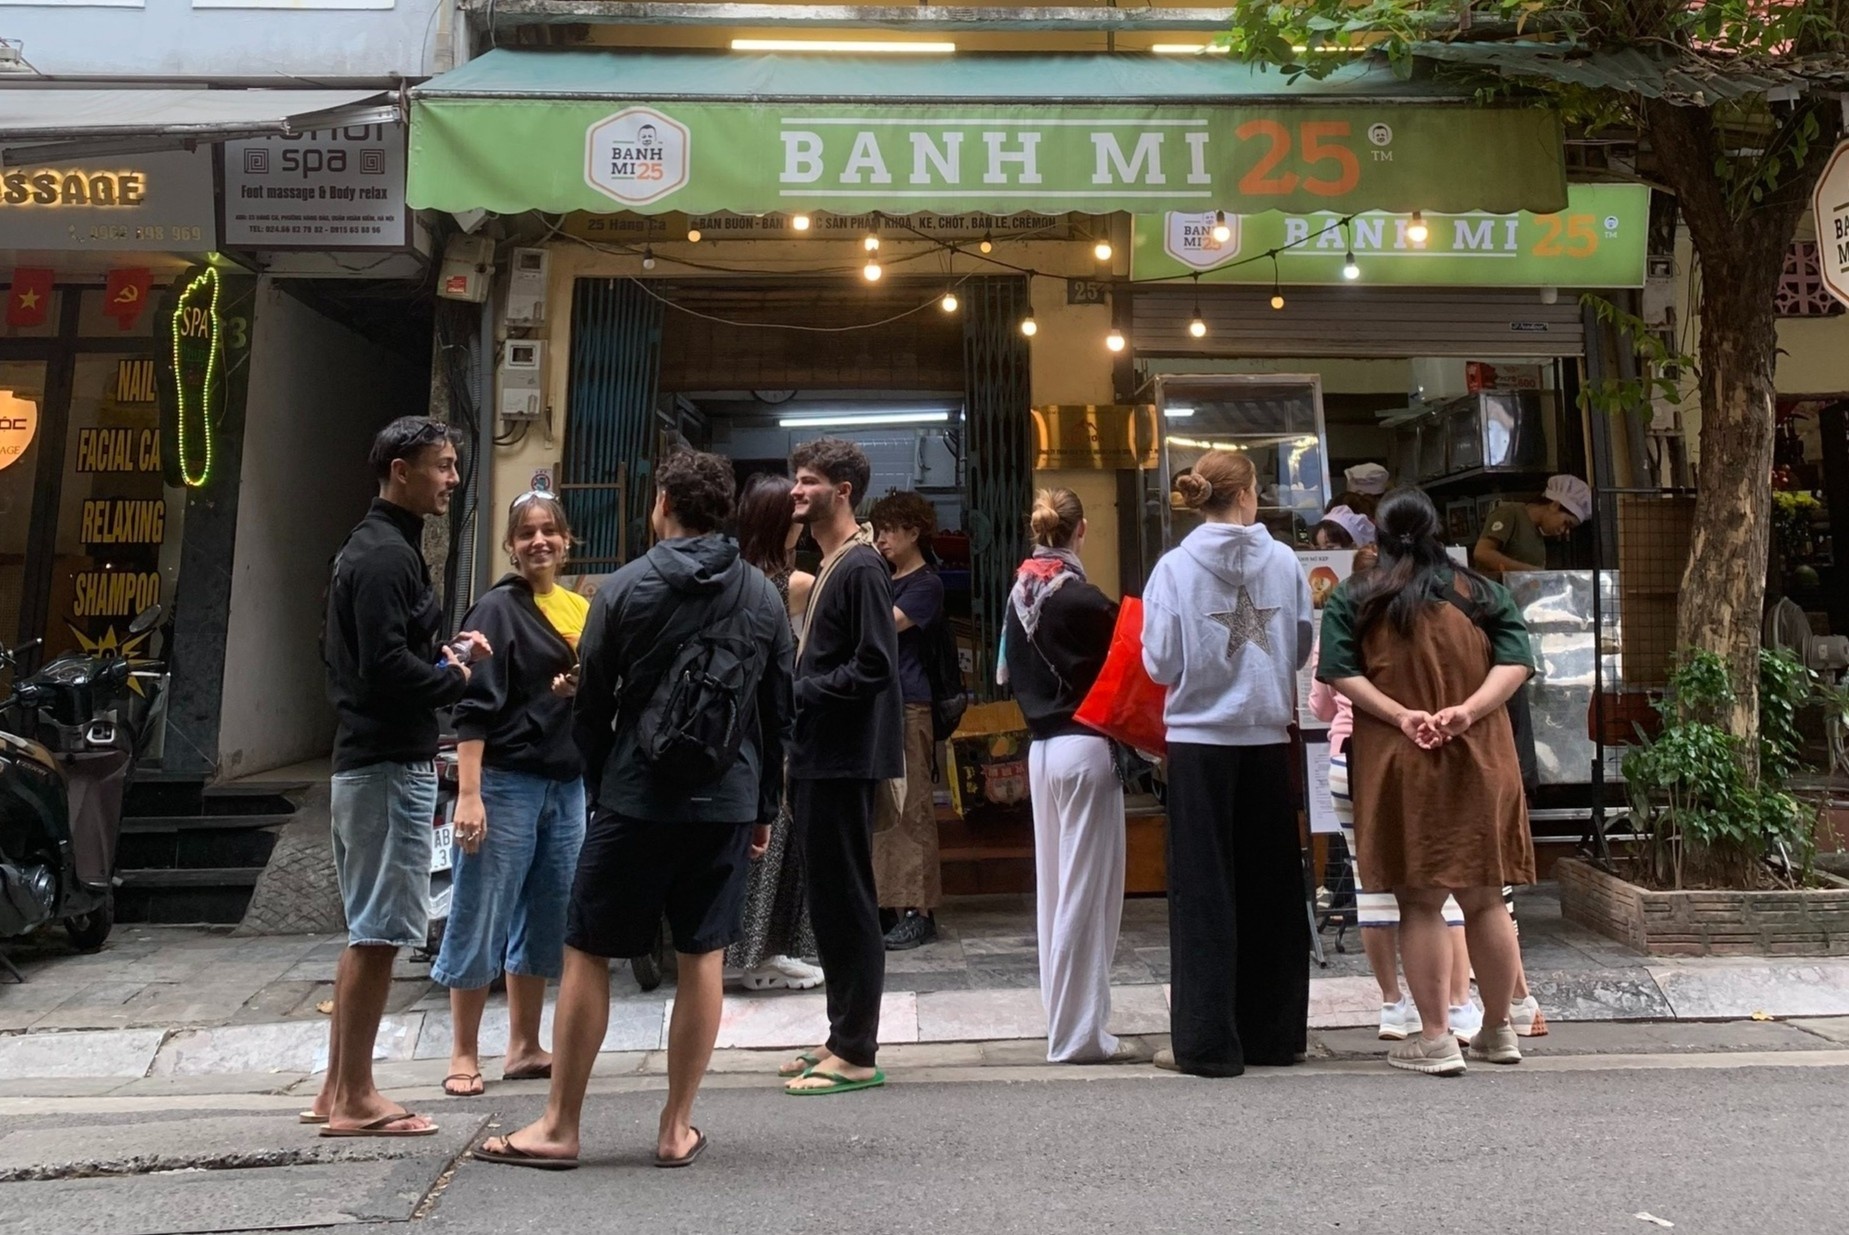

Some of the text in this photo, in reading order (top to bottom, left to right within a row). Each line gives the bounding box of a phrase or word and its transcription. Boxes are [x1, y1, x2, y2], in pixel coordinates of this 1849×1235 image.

[281, 148, 347, 179] spa
[611, 147, 663, 161] BANH
[779, 119, 1393, 197] BANH MI 25 TM
[241, 185, 388, 201] Foot massage & Body relax
[588, 218, 605, 231] 25
[1183, 226, 1218, 237] BAN
[1284, 217, 1427, 249] BANH
[1452, 219, 1519, 250] MI
[1532, 214, 1599, 258] 25
[1074, 281, 1098, 300] 25
[180, 306, 209, 339] SPA
[116, 360, 156, 402] NAIL
[77, 428, 161, 472] FACIAL CA
[80, 500, 166, 543] RELAXING
[73, 572, 160, 617] SHAMPOO
[434, 828, 451, 849] AB
